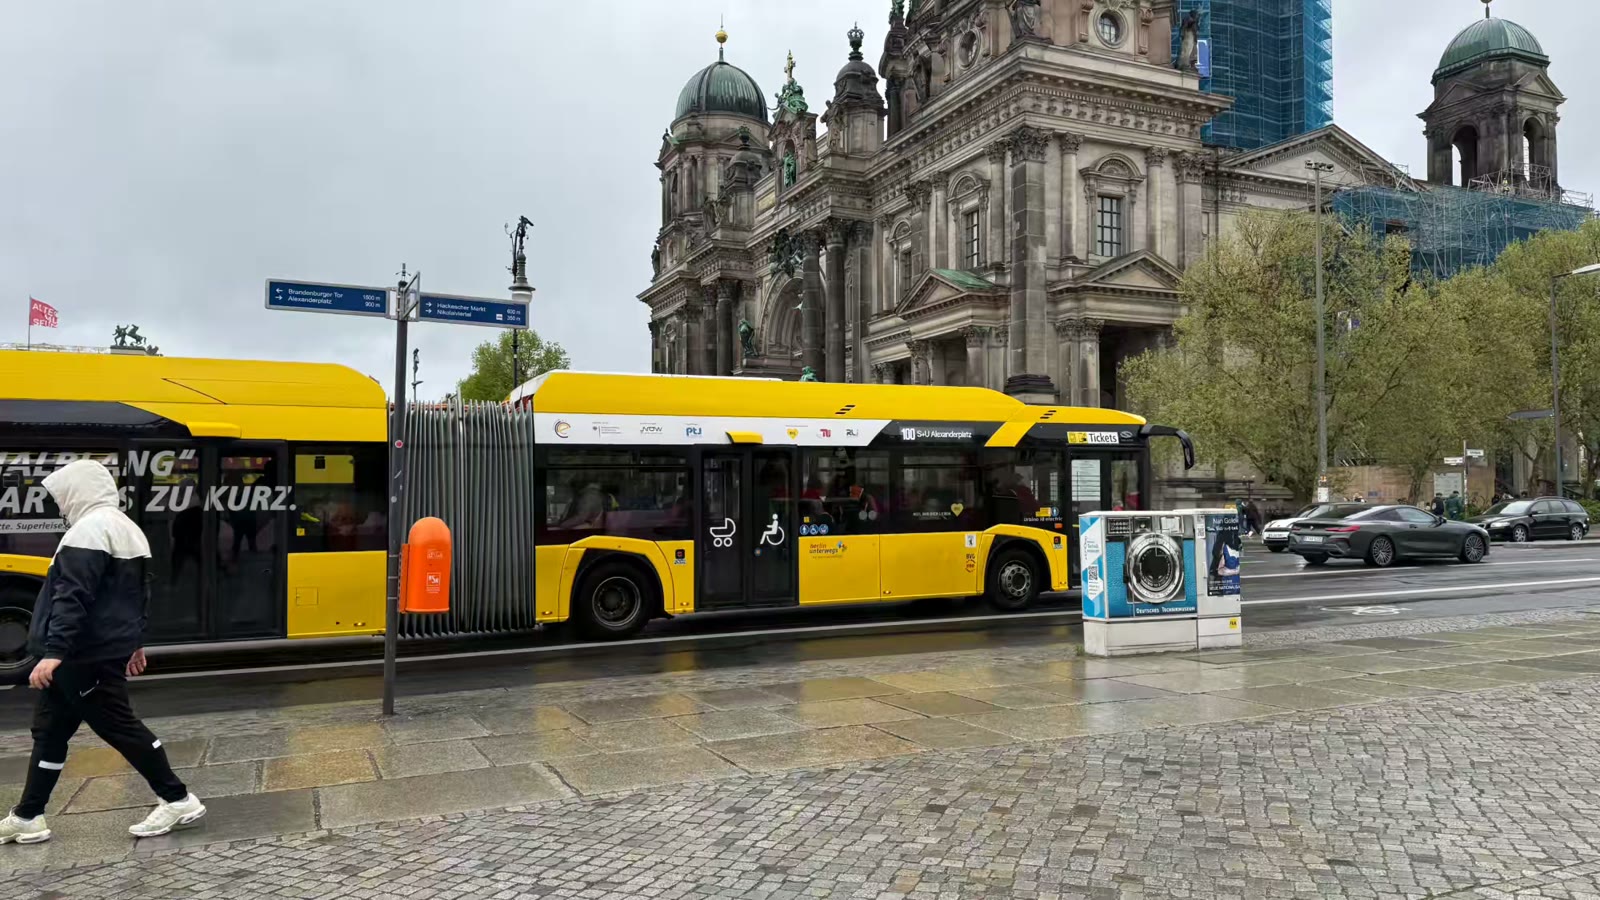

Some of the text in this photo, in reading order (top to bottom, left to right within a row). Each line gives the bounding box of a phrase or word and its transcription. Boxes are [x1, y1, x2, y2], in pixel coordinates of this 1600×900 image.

[288, 288, 333, 298] Brandenburger
[288, 295, 333, 305] Alexanderplatz
[437, 303, 470, 311] Hackescher
[470, 305, 487, 313] Markt
[437, 309, 472, 318] Nikolaiviertel
[901, 428, 972, 440] 100 S+U Alexanderplatz
[1089, 432, 1117, 443] Tickets
[0, 486, 48, 513] AR
[145, 485, 194, 512] ZU
[203, 485, 297, 512] KURZ.
